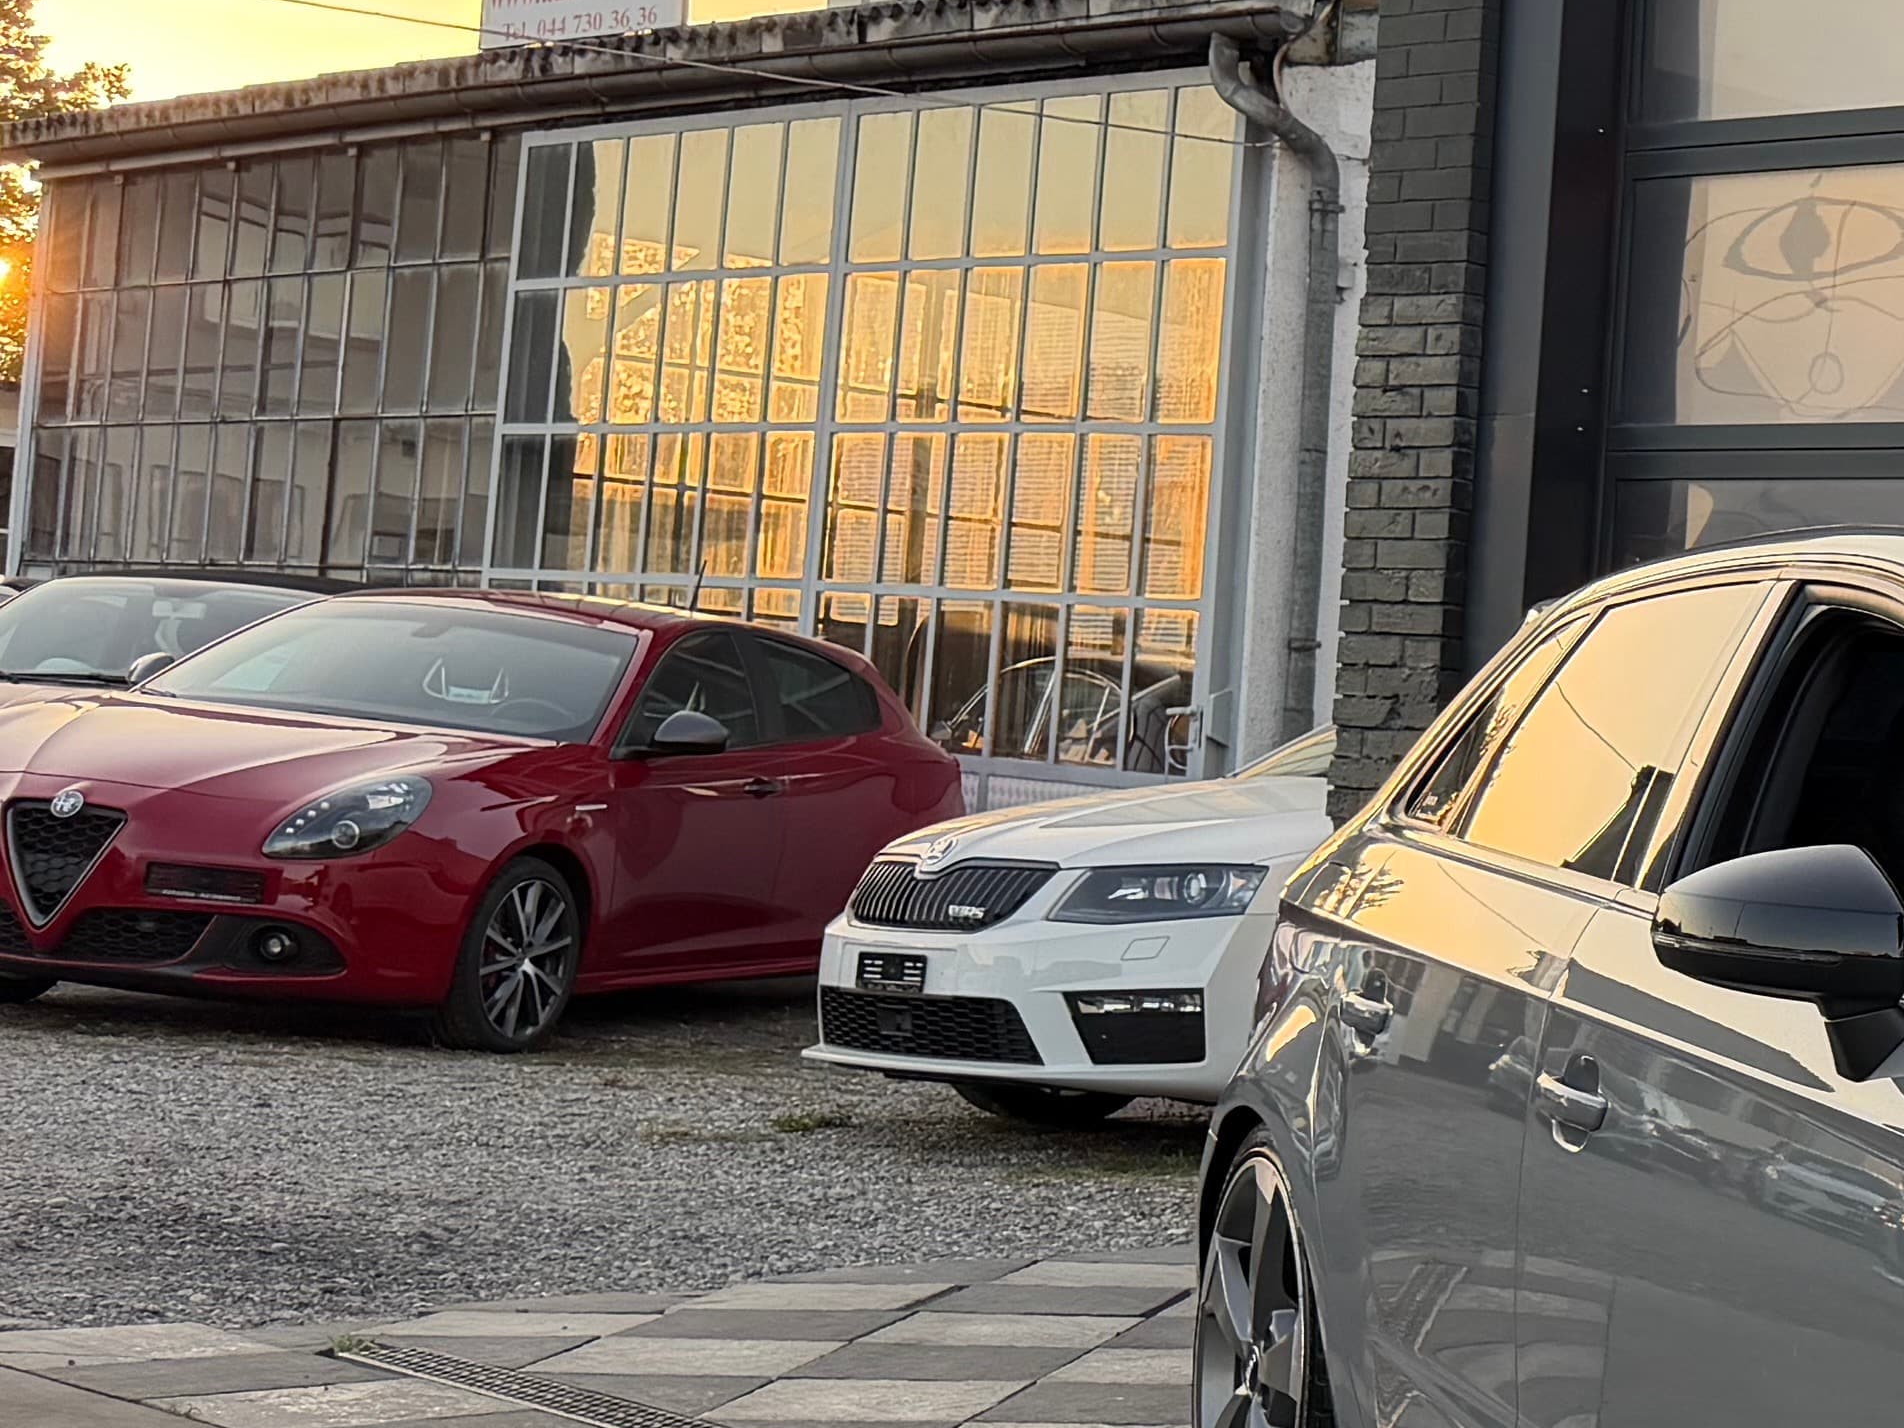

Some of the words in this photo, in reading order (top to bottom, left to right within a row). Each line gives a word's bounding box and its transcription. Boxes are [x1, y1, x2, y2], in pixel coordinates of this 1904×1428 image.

[537, 15, 567, 38] 044
[573, 12, 602, 33] 730
[608, 8, 630, 30] 36
[636, 4, 657, 26] 36
